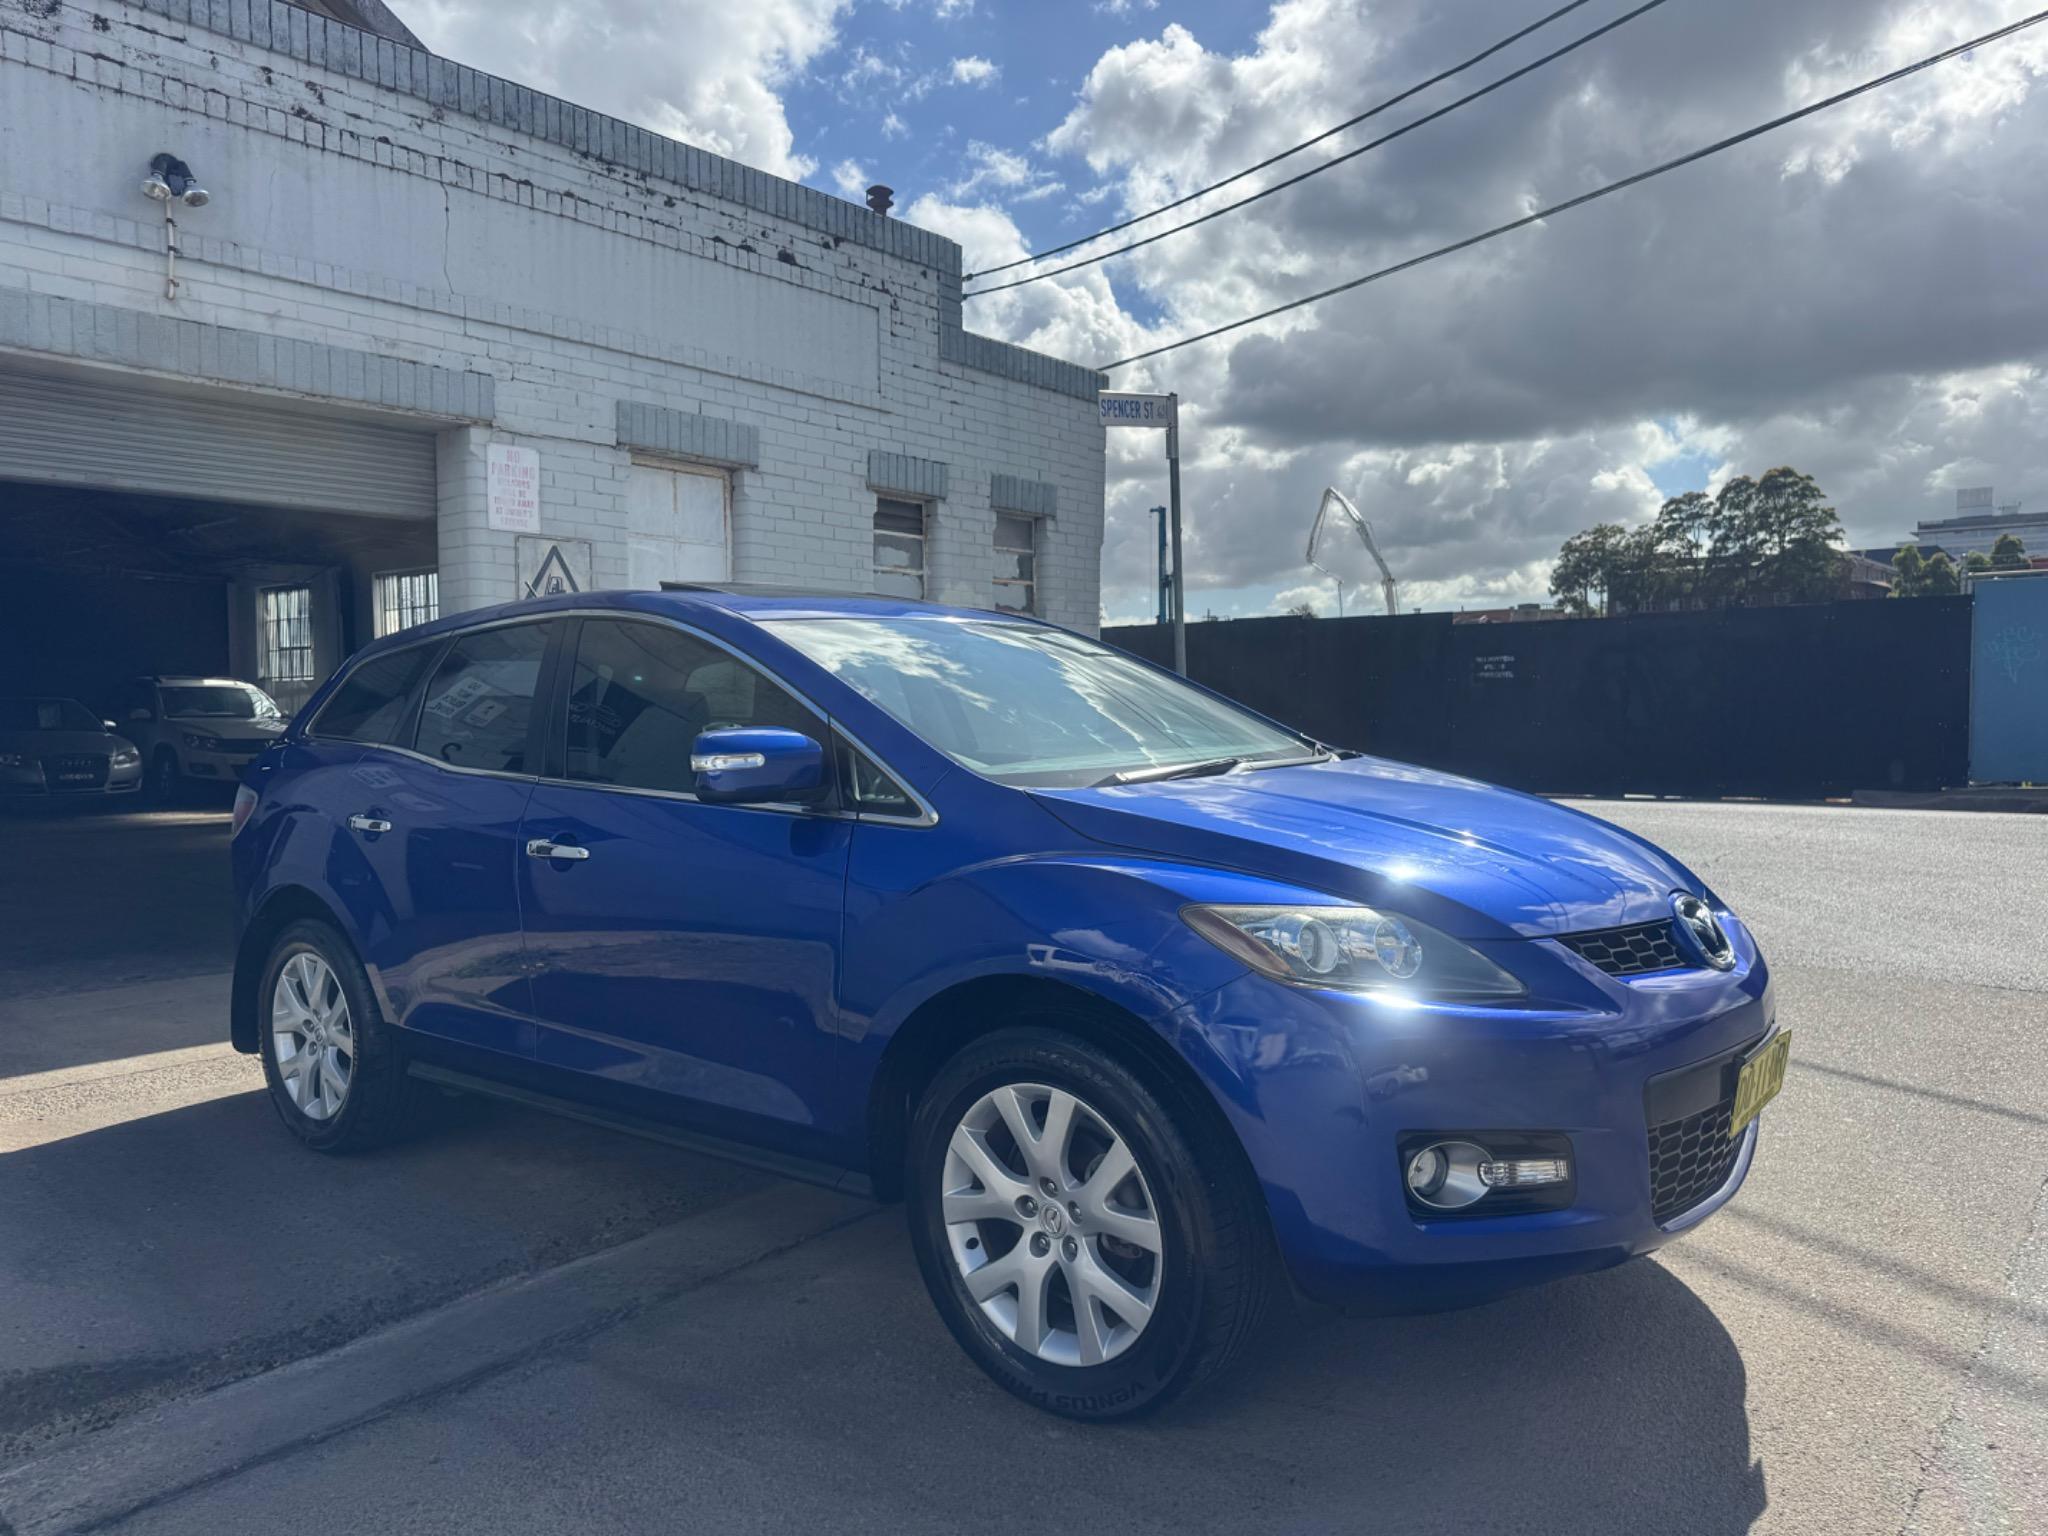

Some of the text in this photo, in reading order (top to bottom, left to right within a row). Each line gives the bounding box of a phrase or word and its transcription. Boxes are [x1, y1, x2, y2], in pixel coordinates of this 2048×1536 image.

[1101, 398, 1141, 419] SPENCER
[1144, 401, 1154, 419] ST
[506, 449, 520, 464] NO
[491, 462, 536, 480] PARKING
